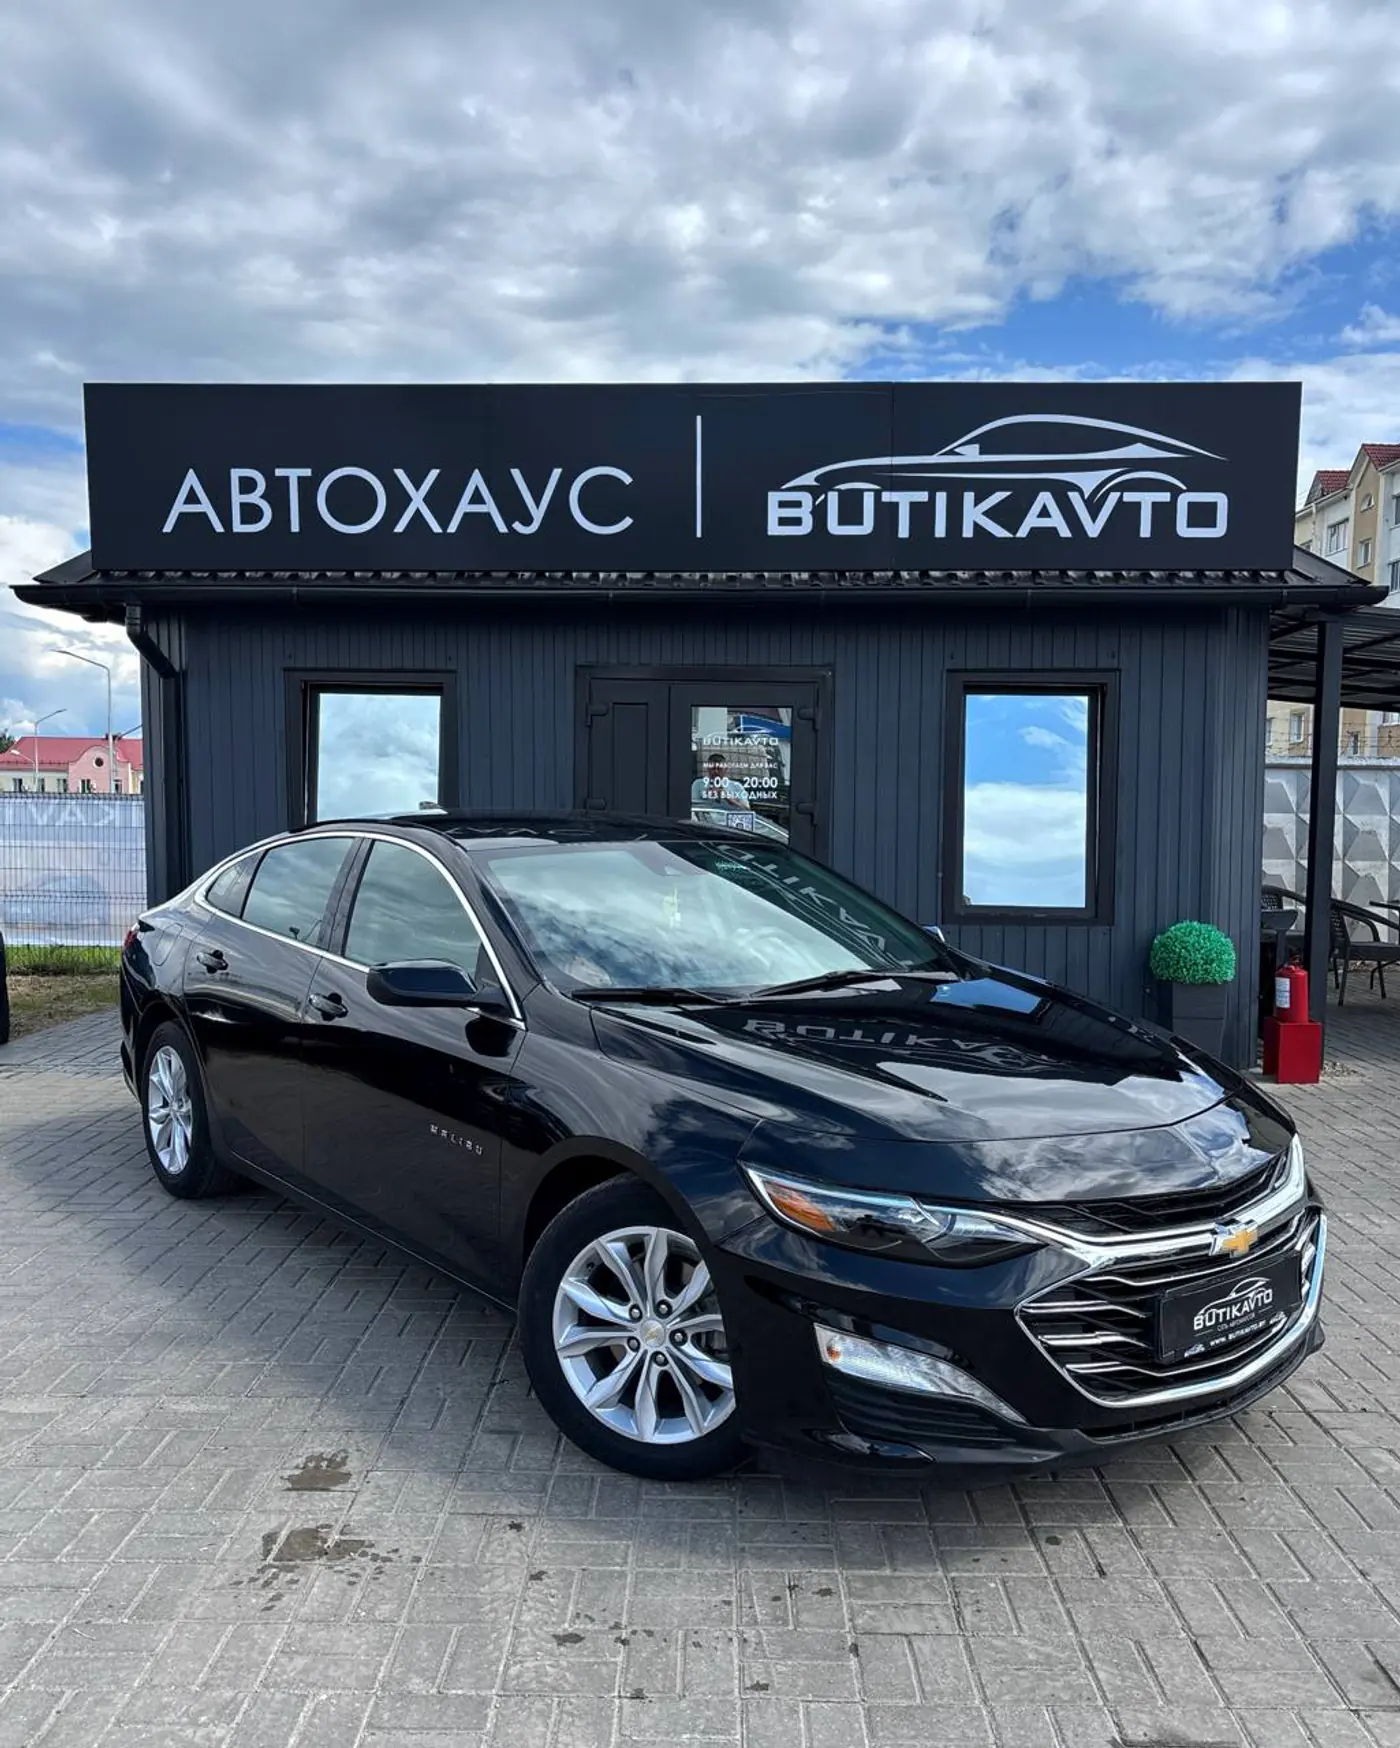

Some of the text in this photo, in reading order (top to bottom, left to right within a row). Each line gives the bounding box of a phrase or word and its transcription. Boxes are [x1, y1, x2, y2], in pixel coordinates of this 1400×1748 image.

[162, 466, 634, 535] АВТОХАУС
[766, 490, 1229, 538] BUTIKAVTO
[702, 791, 778, 799] БЕЗ ВЫХОДНЫХ
[703, 776, 778, 788] 9:00 20:00
[429, 1124, 484, 1155] MALIBU
[1193, 1288, 1273, 1330] BUTIKAVTO
